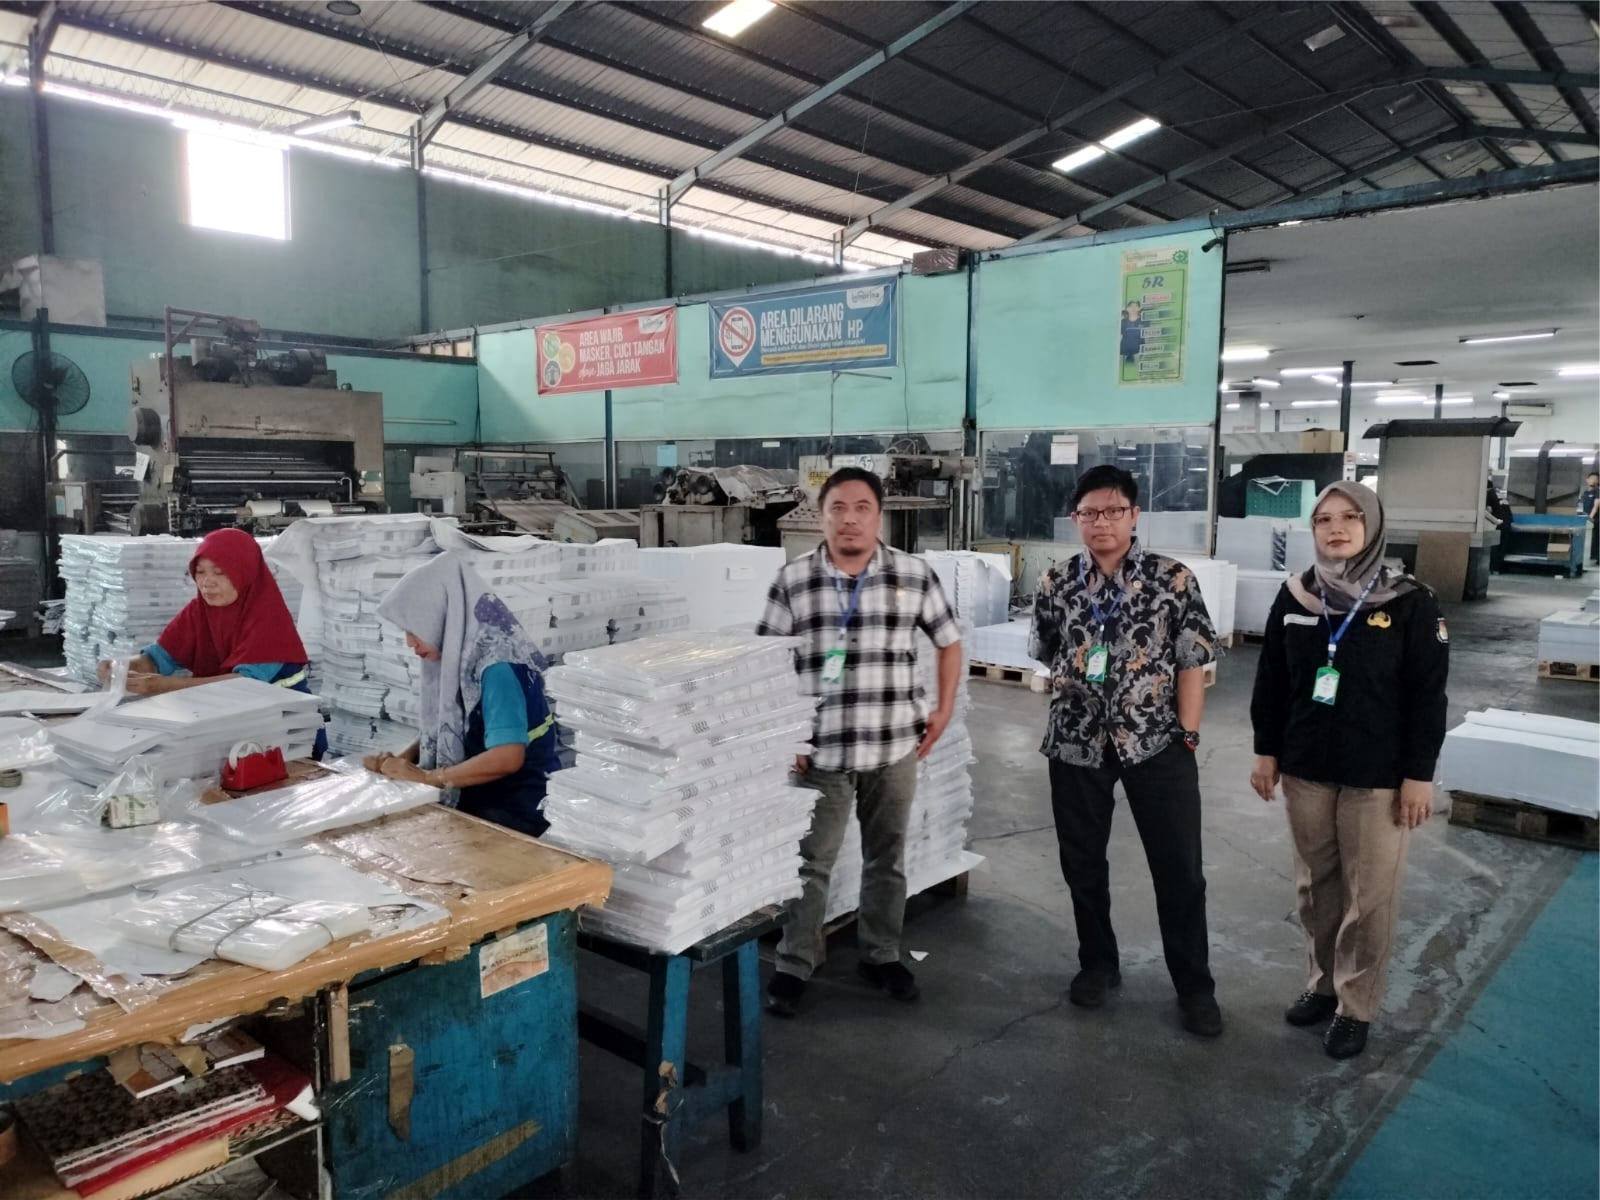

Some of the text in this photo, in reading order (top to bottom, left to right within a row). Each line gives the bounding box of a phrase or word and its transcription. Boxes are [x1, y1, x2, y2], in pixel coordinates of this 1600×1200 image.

[761, 303, 844, 330] AREA DILARANG
[579, 327, 623, 347] AREA WAJIB
[761, 319, 863, 346] MENGGUNAKAN HP
[613, 343, 632, 359] CUCI
[633, 338, 665, 357] TANGAN
[596, 360, 614, 377] JAGA
[616, 358, 641, 375] JARAK
